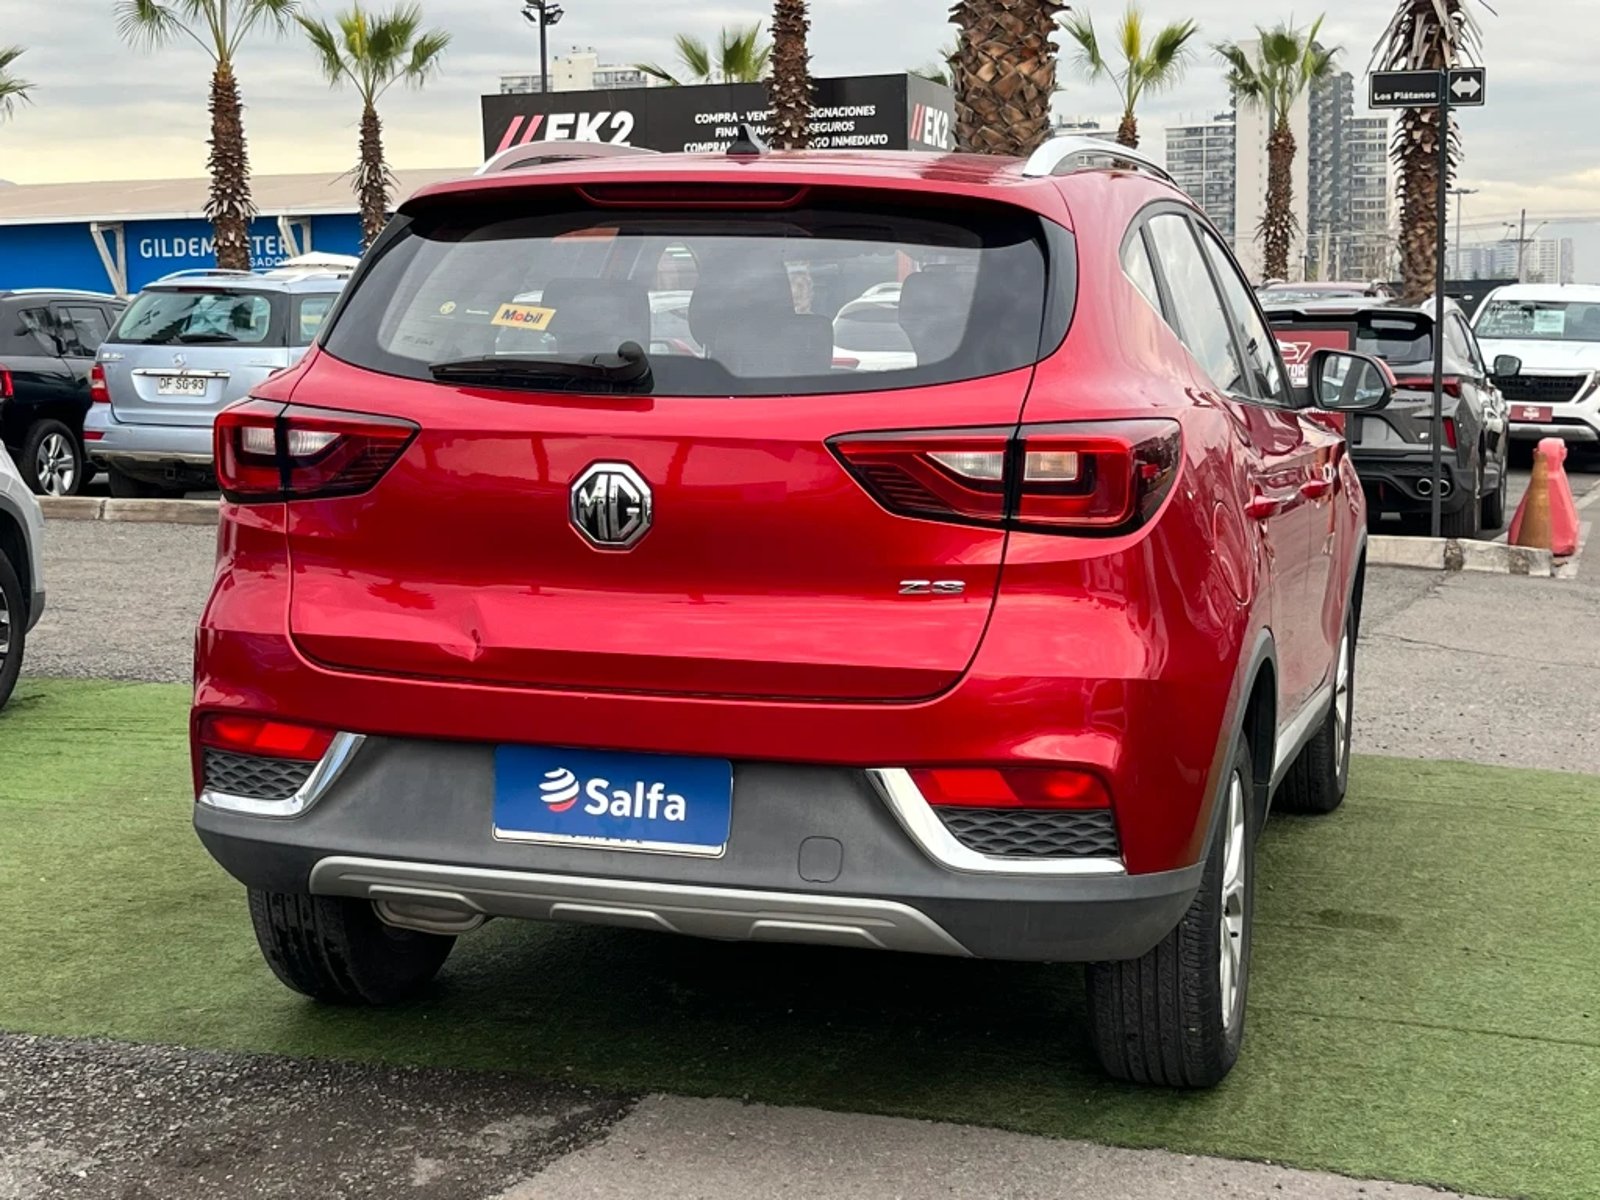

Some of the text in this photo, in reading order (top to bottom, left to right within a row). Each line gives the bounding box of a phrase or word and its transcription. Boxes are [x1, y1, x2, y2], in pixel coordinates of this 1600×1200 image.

[694, 112, 739, 124] COMPRA
[809, 121, 855, 133] SEGUROS
[923, 106, 949, 149] EK2
[831, 134, 888, 147] INMEDIATO
[501, 308, 544, 324] Mobil
[579, 473, 641, 540] MG
[898, 579, 966, 595] ZS
[584, 778, 687, 822] Salfa
